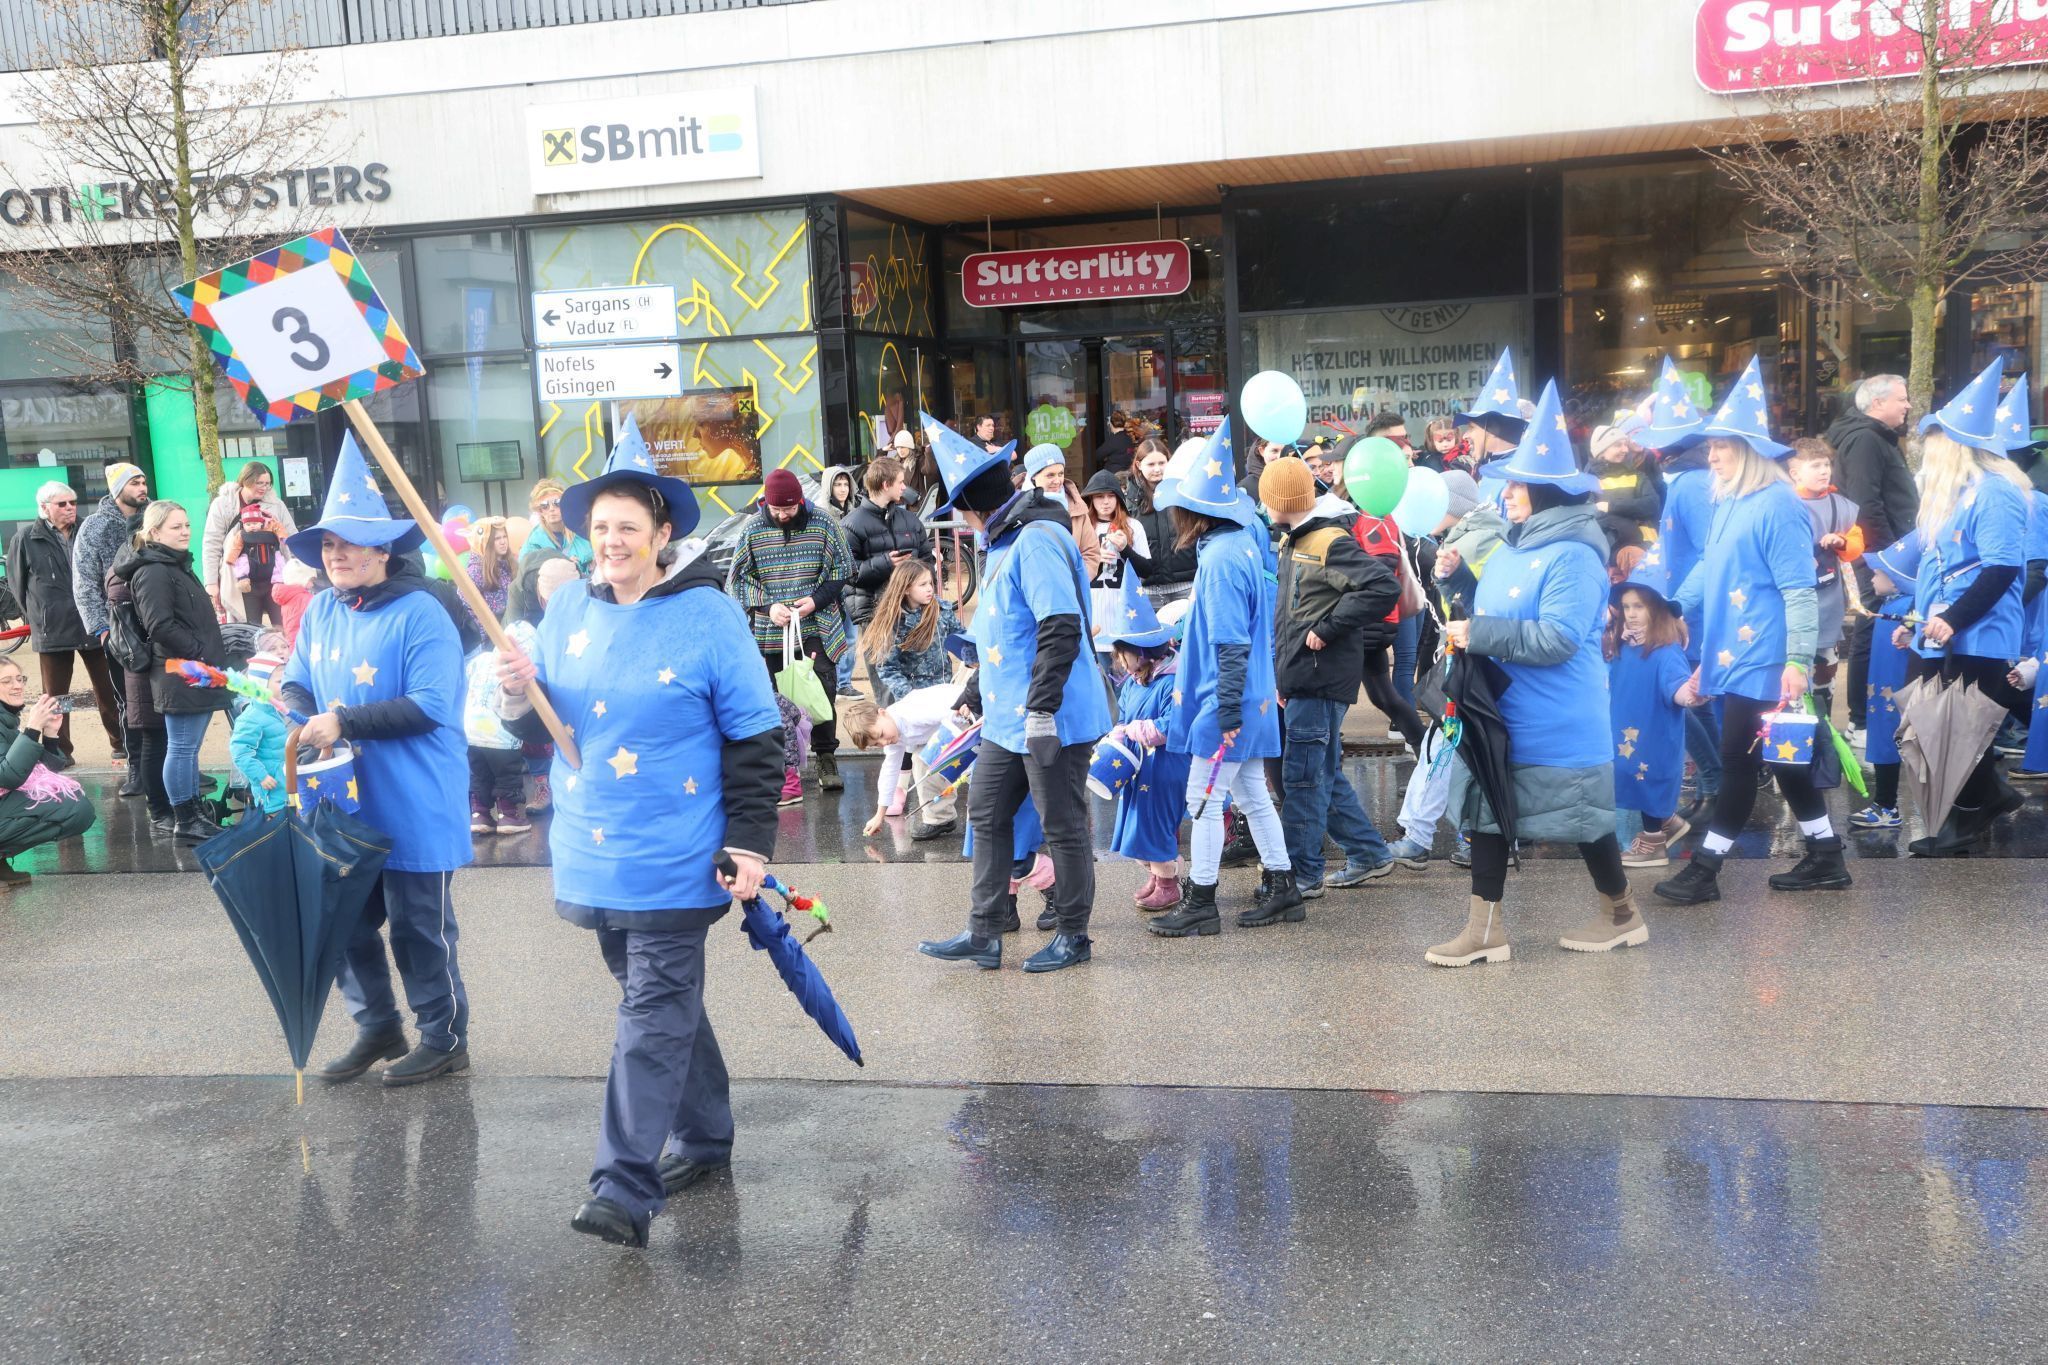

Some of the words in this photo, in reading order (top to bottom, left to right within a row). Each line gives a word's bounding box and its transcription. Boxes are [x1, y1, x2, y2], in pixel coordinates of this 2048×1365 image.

[580, 116, 704, 164] SBmit
[189, 162, 392, 214] TOSTERS
[977, 250, 1176, 287] Sutterlüty
[979, 291, 1018, 302] MEIN
[1034, 281, 1171, 298] LÄNDLEMARKT
[565, 297, 631, 316] Sargans
[638, 296, 651, 307] CH
[271, 306, 330, 372] 3
[566, 319, 616, 336] Vaduz
[623, 319, 635, 330] FL
[544, 356, 596, 373] Nofels
[1291, 350, 1372, 372] HERZLICH
[1379, 342, 1497, 367] WILLKOMMEN
[545, 378, 616, 397] Gisingen
[1300, 377, 1331, 398] EIM
[1467, 365, 1490, 388] FÜ
[1400, 396, 1478, 419] PRODUKT
[653, 440, 686, 451] WERT.
